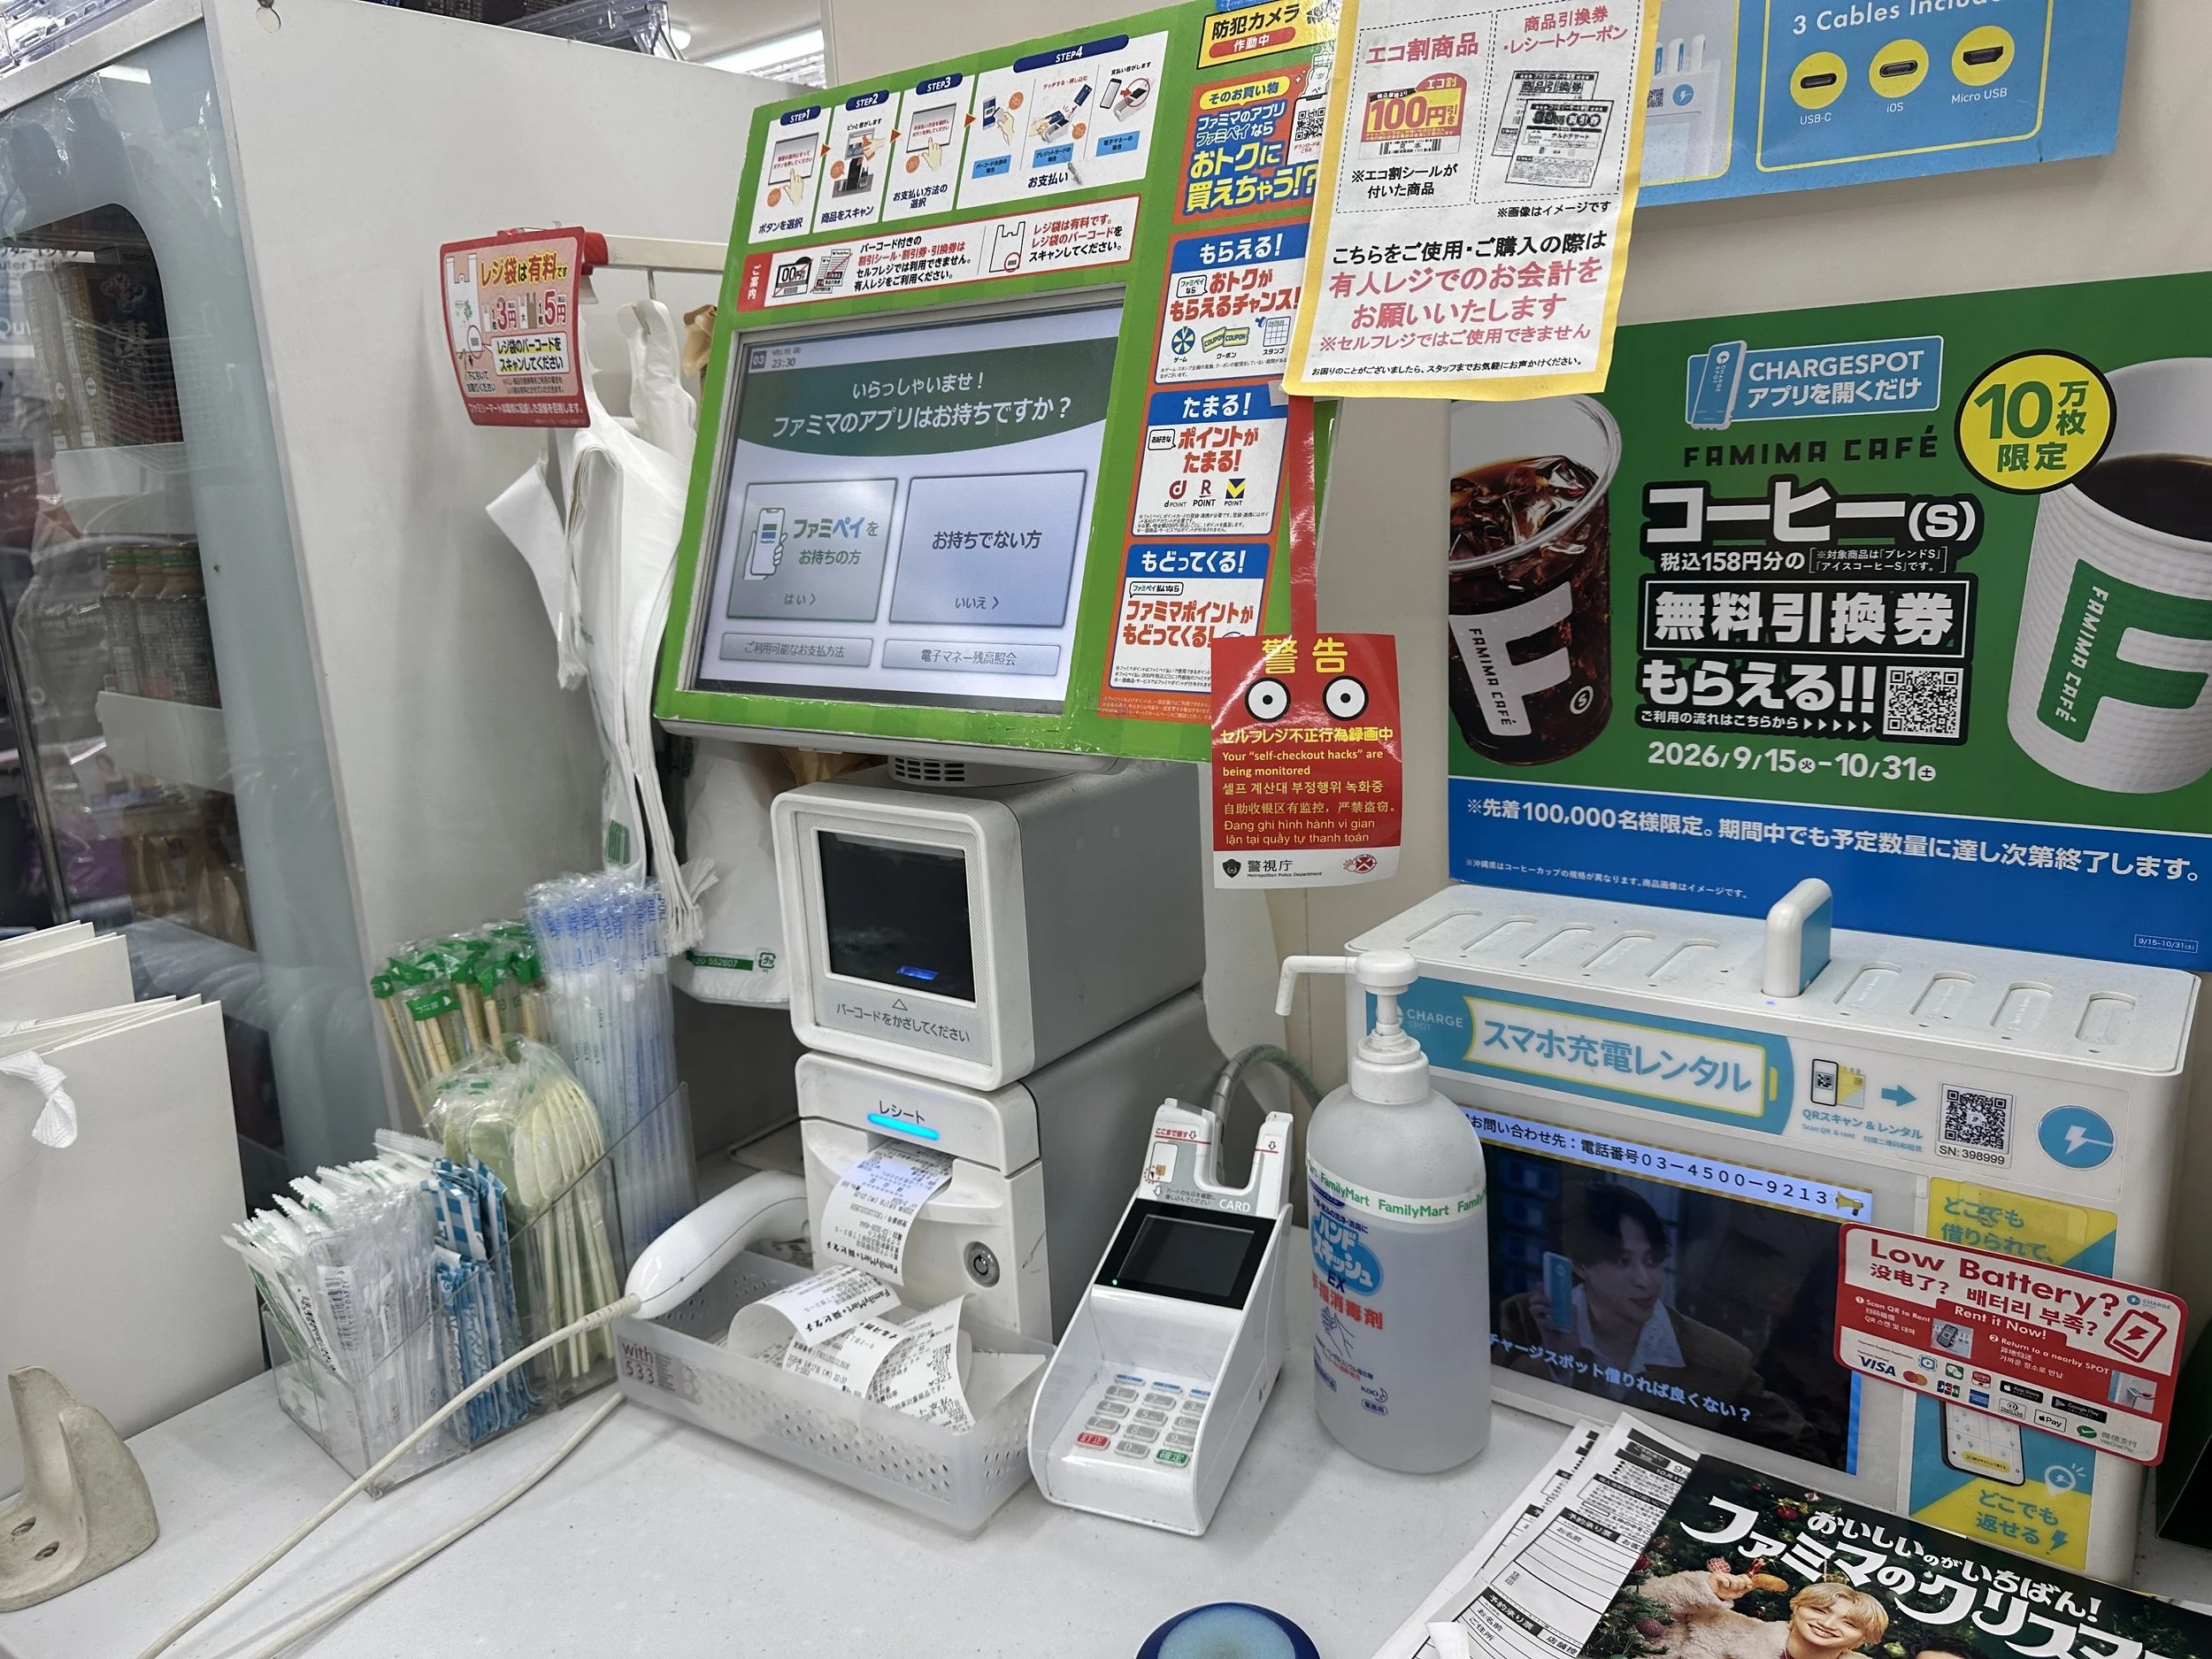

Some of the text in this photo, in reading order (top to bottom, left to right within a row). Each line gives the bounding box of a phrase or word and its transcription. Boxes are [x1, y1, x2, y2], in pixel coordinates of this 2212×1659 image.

[1211, 4, 1300, 41] 防犯カメラ
[1523, 7, 1609, 34] 商品引換券
[1793, 3, 1901, 35] 3 Cables
[1233, 35, 1270, 52] 作動中
[1365, 31, 1479, 65] エコ割商品
[1056, 46, 1084, 64] STEP4
[926, 76, 951, 92] STEP3
[1209, 82, 1279, 104] そのお買い物
[1426, 77, 1457, 89] エコ割
[856, 94, 879, 108] STEP2
[1951, 88, 2008, 104] Micro USB
[789, 111, 810, 124] STEP1
[1197, 102, 1286, 132] ファミマのアプリ
[1800, 111, 1832, 126] USB-C
[1886, 102, 1904, 113] iOS
[1196, 121, 1274, 147] ファミペイなら
[1191, 142, 1280, 179] おトクに
[1027, 173, 1069, 188] お支払い
[1351, 163, 1458, 184] ※エコ割シールが
[893, 184, 948, 202] お支払い方法の
[1367, 180, 1435, 200] 付いた商品
[910, 197, 926, 210] 選択
[1496, 200, 1611, 219] ※画像はイメージです
[758, 218, 803, 234] ボタンを選択
[820, 206, 874, 225] 商品をスキャン
[1033, 213, 1112, 235] レジ袋は有料です。
[860, 235, 921, 253] バーコード付きの
[1031, 226, 1123, 249] レジ袋のバーコードを
[1333, 230, 1608, 265] こちらをご使用・ご購入の際は
[1029, 242, 1122, 263] スキャンしてください。
[481, 253, 568, 288] レジ袋は有料です
[856, 255, 972, 279] セルフレジでは利用できません。
[1329, 256, 1602, 298] 有人レジでのお会計を
[853, 272, 954, 292] 有人レジをご利用ください。
[1210, 268, 1273, 294] おトクが
[1351, 292, 1567, 329] お願いいたします
[1320, 323, 1591, 351] ※セルフレジではご使用できません
[499, 356, 564, 373] スキャンしてください
[772, 357, 796, 369] 23:30
[1748, 350, 1924, 381] CHARGESPOT
[1747, 378, 1922, 409] アプリを開くだけ
[772, 396, 1072, 439] ファミマのアプリはお持ちですか？
[1178, 426, 1259, 449] ポイントが
[1685, 426, 1939, 468] FAMIMA CAFÉ
[1996, 442, 2068, 472] 限定
[793, 517, 879, 540] ファミペイを
[932, 530, 1042, 551] お持ちでない方
[798, 549, 862, 566] お持ちの方
[1661, 551, 1806, 573] 税込158円分の
[955, 596, 987, 611] いいえ
[1125, 599, 1254, 625] ファミマポイントが
[1655, 591, 1954, 646] 無料引換券
[743, 641, 846, 660] ご利用可能なお支払方法
[921, 649, 1018, 667] 電子マネー残高照会
[1262, 637, 1348, 674] 警告
[2055, 585, 2109, 723] FAMIMA CAFÉ
[1469, 627, 1517, 726] FAMIMA CAFÉ
[1640, 710, 1799, 731] ご利用の流れはこちらから
[1220, 726, 1394, 744] セルフレジ不正行為録画中
[1223, 750, 1383, 762] Your are
[1223, 765, 1310, 778] being monitored
[1223, 780, 1384, 795] 셀프 계산대 부정행위 녹화중
[1225, 818, 1375, 832] Đang ghi hình hành vi gian
[1226, 832, 1370, 846] lận tại quầy thanh toán
[1248, 859, 1293, 872] 警視庁
[836, 1002, 971, 1044] バーコードをかざしてください
[1407, 1009, 1464, 1028] CHARGE
[1409, 1021, 1432, 1032] SPOT
[1484, 1018, 1753, 1093] スマホ充電レンタル
[879, 1100, 926, 1125] レシート
[1802, 1109, 1923, 1140] QRスキャン & レンタル
[1939, 1145, 2005, 1165] SN: 398999
[1219, 1199, 1251, 1212] CARD
[1320, 1171, 1371, 1207] FamilyMart
[1379, 1199, 1450, 1219] FamilyMart
[1944, 1196, 2025, 1229] どこでも
[1319, 1213, 1359, 1251] ハンド
[1327, 1271, 1346, 1294] EX
[1870, 1238, 2120, 1318] Low Battery?
[1866, 1299, 1931, 1323] Scan QR Rent
[1966, 1286, 2031, 1320] 배터리
[2142, 1298, 2171, 1310] CHARGE
[1955, 1305, 2047, 1340] Rent it Now!
[1858, 1355, 1896, 1377] VISA
[2001, 1338, 2109, 1374] Return nearby SPOT
[2046, 1416, 2062, 1427] Pay
[1978, 1489, 2059, 1526] どこでも
[1556, 1525, 1582, 1542] お名前
[1976, 1512, 2040, 1546] 返せる
[1468, 1617, 1494, 1642] ご住所
[1477, 1607, 1504, 1632] お名前
[1546, 1635, 1579, 1657] 店舗控
